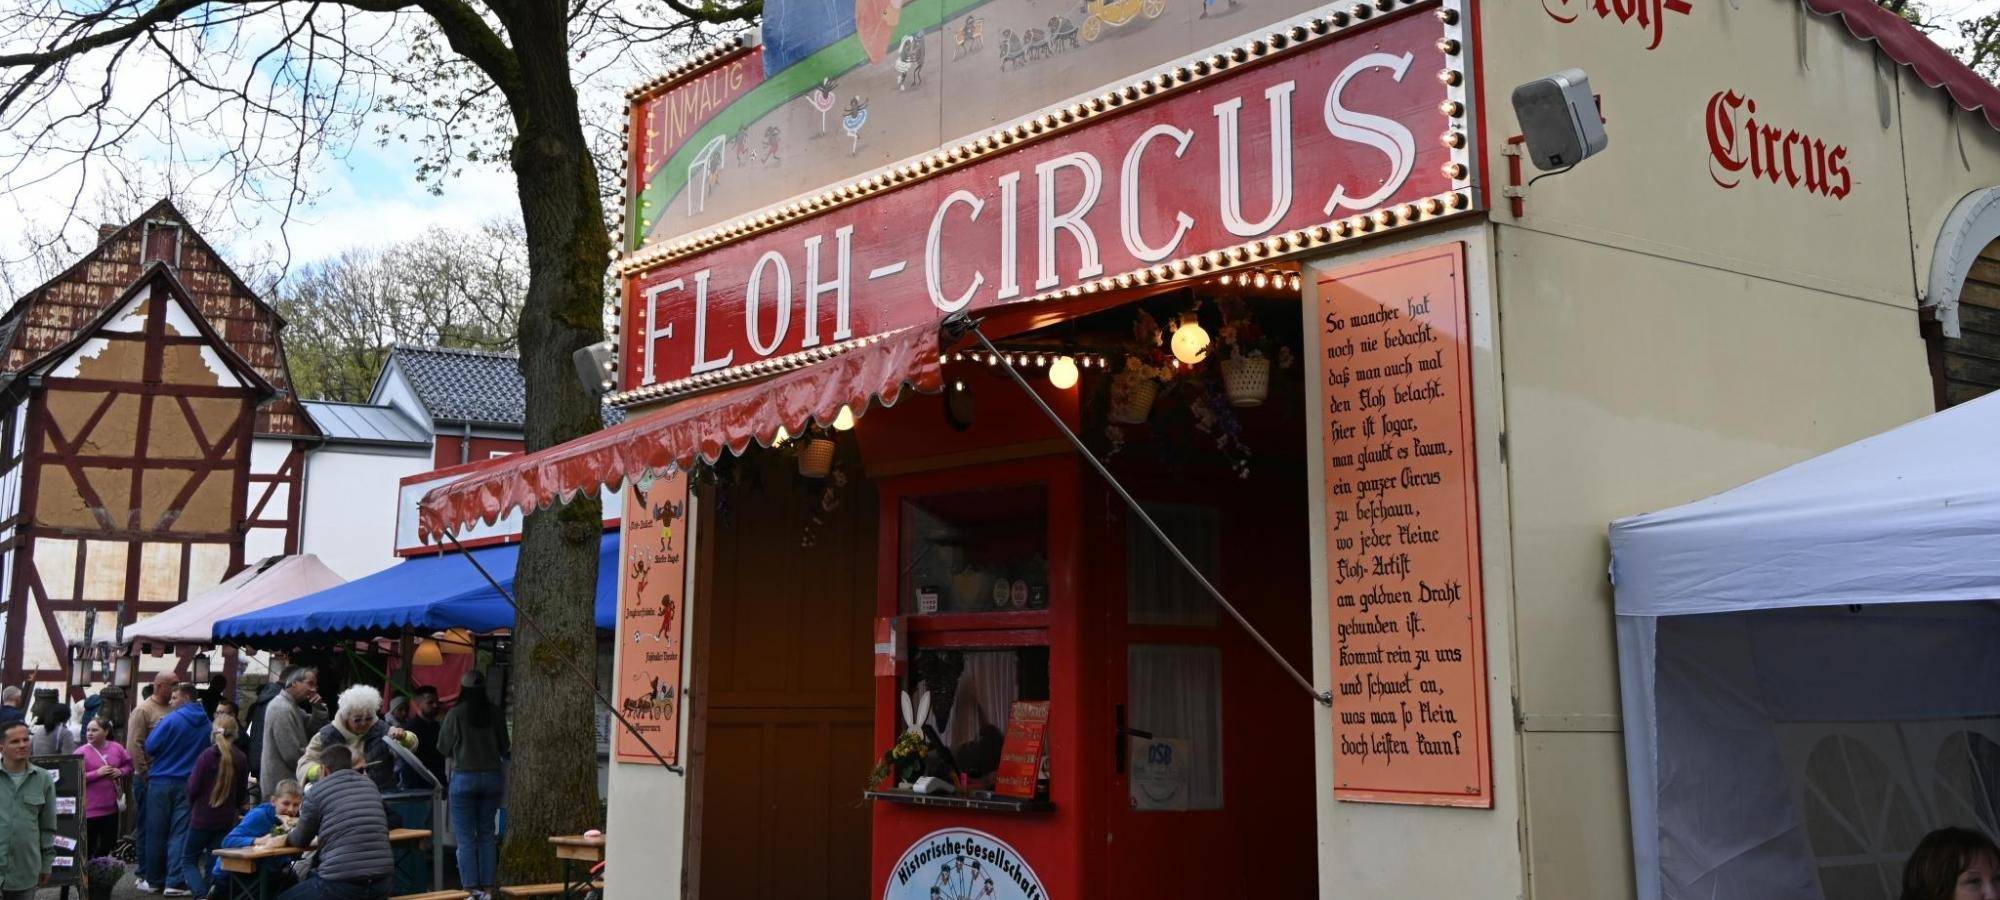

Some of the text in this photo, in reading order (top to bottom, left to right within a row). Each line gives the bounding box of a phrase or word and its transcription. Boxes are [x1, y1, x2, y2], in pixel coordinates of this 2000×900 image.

[646, 63, 743, 170] EINMALIG
[1705, 89, 1852, 200] Circus
[641, 51, 1415, 386] FLOH-CIRCUS
[1326, 294, 1431, 332] So mancher hat
[1328, 323, 1437, 358] noch nie bedacht,
[1356, 366, 1381, 380] man
[1384, 353, 1413, 378] auch
[1418, 348, 1443, 371] mal
[1330, 377, 1445, 414] den Floh belacht.
[1332, 437, 1453, 471] man glaubt es kaum,
[1333, 467, 1441, 500] ein ganzer Circus
[1334, 509, 1349, 530] zu
[1336, 522, 1440, 555] wo jeder kleine
[1335, 557, 1368, 584] Floh-
[1337, 580, 1461, 613] am goldnen Draht
[1337, 616, 1399, 644] gebunden
[1386, 646, 1412, 664] rein
[1413, 648, 1431, 670] zu
[1435, 649, 1462, 662] uns
[1340, 674, 1363, 696] und
[1420, 680, 1444, 695] an,
[1340, 712, 1365, 725] was
[1370, 711, 1397, 725] man
[1418, 701, 1457, 725] klein
[1341, 733, 1368, 765] doch
